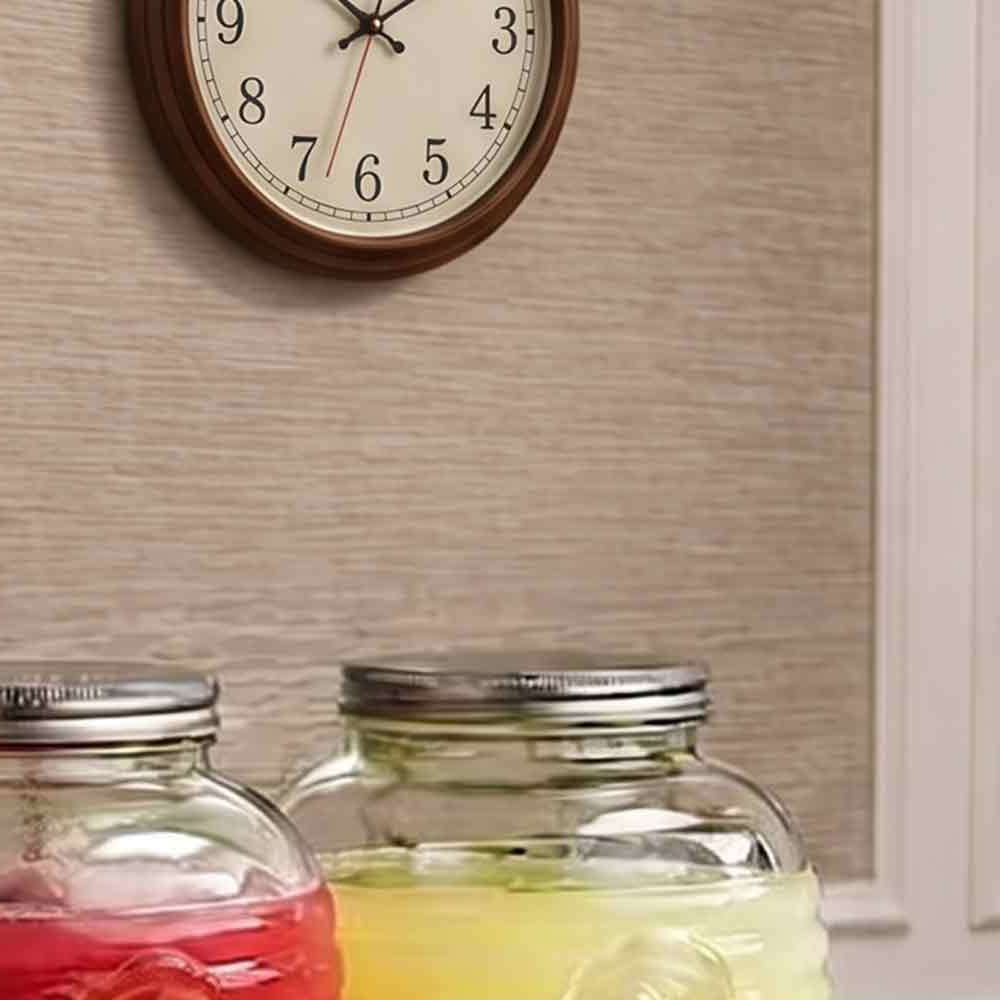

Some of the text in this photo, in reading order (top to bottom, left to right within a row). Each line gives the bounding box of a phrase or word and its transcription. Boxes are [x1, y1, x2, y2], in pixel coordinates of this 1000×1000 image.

[216, 0, 244, 45] 9
[491, 6, 518, 54] 3
[238, 76, 266, 124] 8
[469, 84, 497, 129] 4
[290, 136, 318, 181] 7
[354, 153, 382, 202] 6
[422, 139, 449, 185] 5
